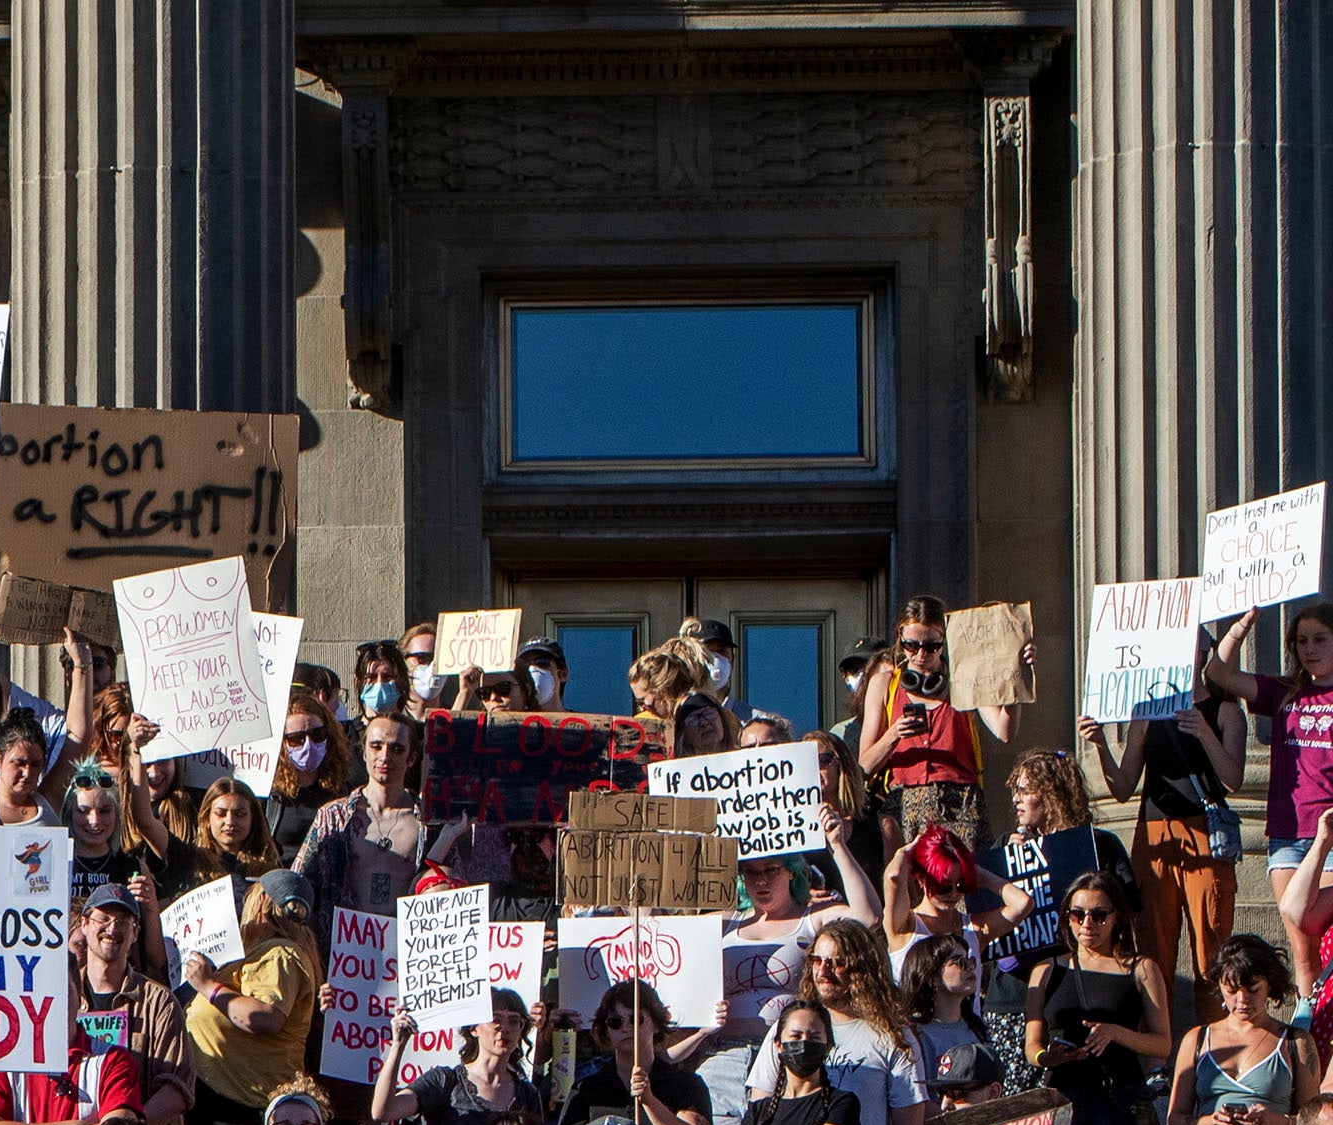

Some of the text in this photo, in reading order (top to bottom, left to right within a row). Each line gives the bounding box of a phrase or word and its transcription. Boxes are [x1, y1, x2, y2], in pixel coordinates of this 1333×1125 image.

[1221, 521, 1301, 562] CHOICE.
[456, 613, 499, 637] ABORT
[445, 636, 507, 668] SCOTUS
[1115, 644, 1141, 669] IS
[151, 660, 188, 691] KEEP
[176, 716, 204, 734] OUR
[690, 759, 793, 792] abortion
[338, 913, 390, 949] MAY
[406, 945, 477, 973] FORCED
[405, 963, 470, 990] BIRTH
[402, 979, 487, 1011] EXTREMIST
